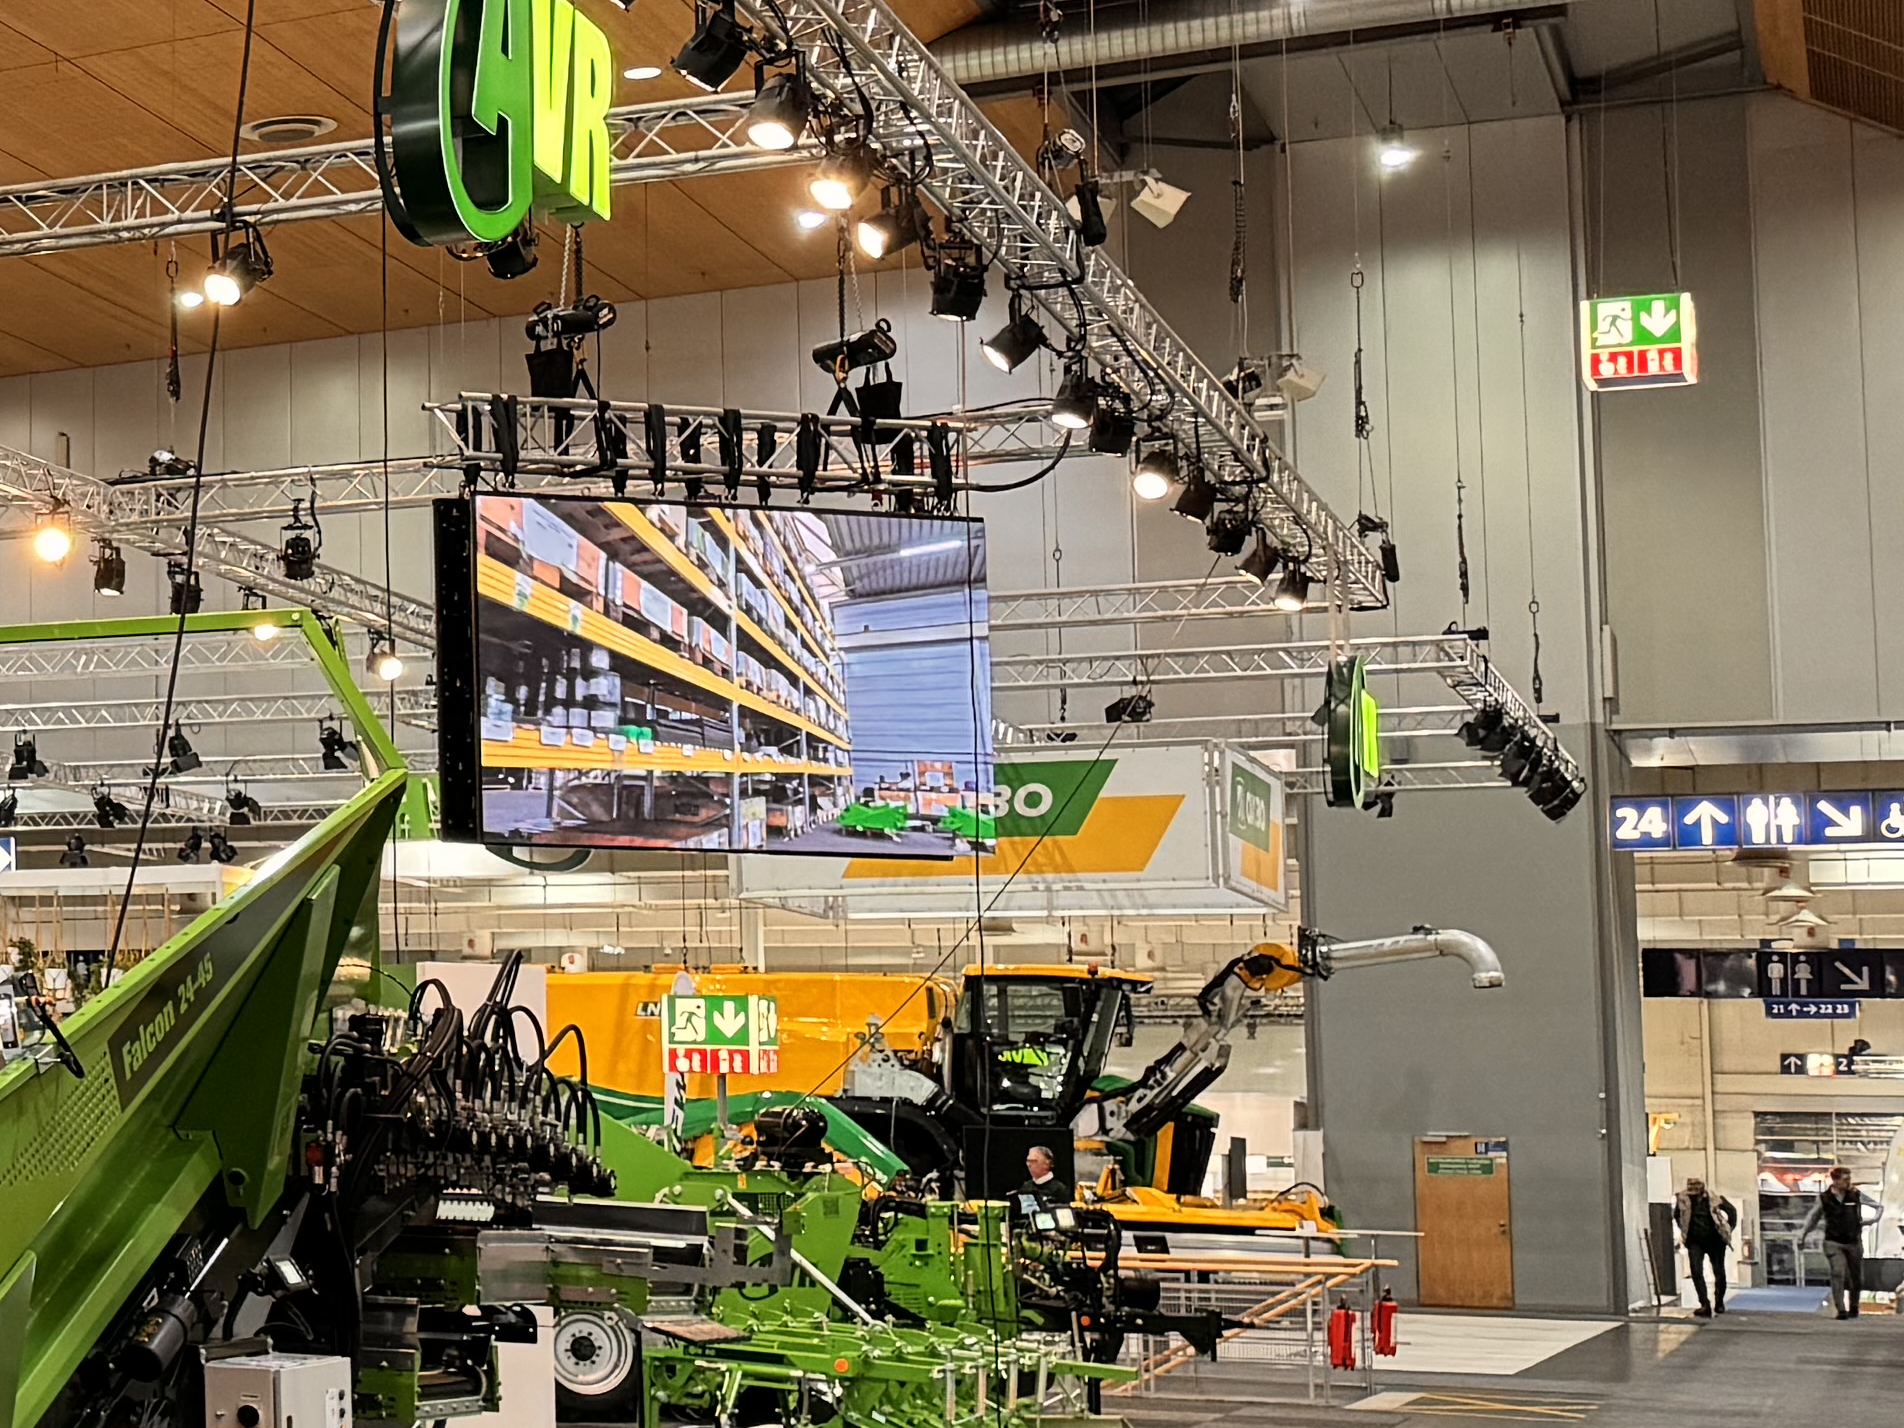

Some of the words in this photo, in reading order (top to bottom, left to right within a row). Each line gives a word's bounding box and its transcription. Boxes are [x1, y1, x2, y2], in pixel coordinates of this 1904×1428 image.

[1616, 806, 1668, 840] 24
[122, 1000, 176, 1081] Falcon
[178, 952, 213, 1014] 24-45
[635, 1002, 661, 1016] LN
